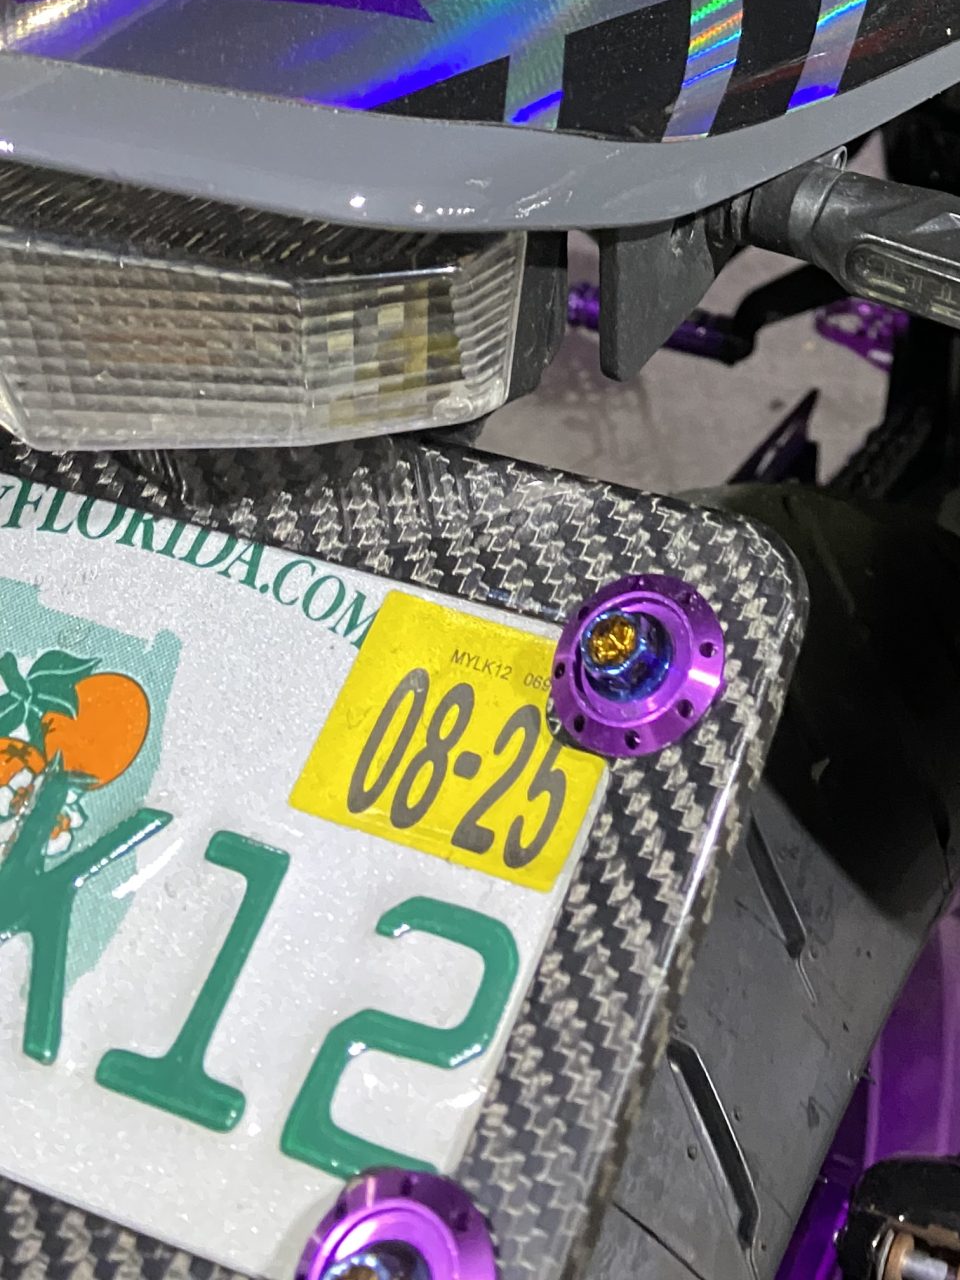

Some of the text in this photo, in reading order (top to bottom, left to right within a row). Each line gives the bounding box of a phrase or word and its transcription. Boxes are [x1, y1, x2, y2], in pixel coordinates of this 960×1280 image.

[0, 479, 379, 650] FLORIDA.COM
[451, 649, 513, 681] MYLK12
[347, 666, 567, 869] 08-25
[0, 770, 520, 1180] K12
